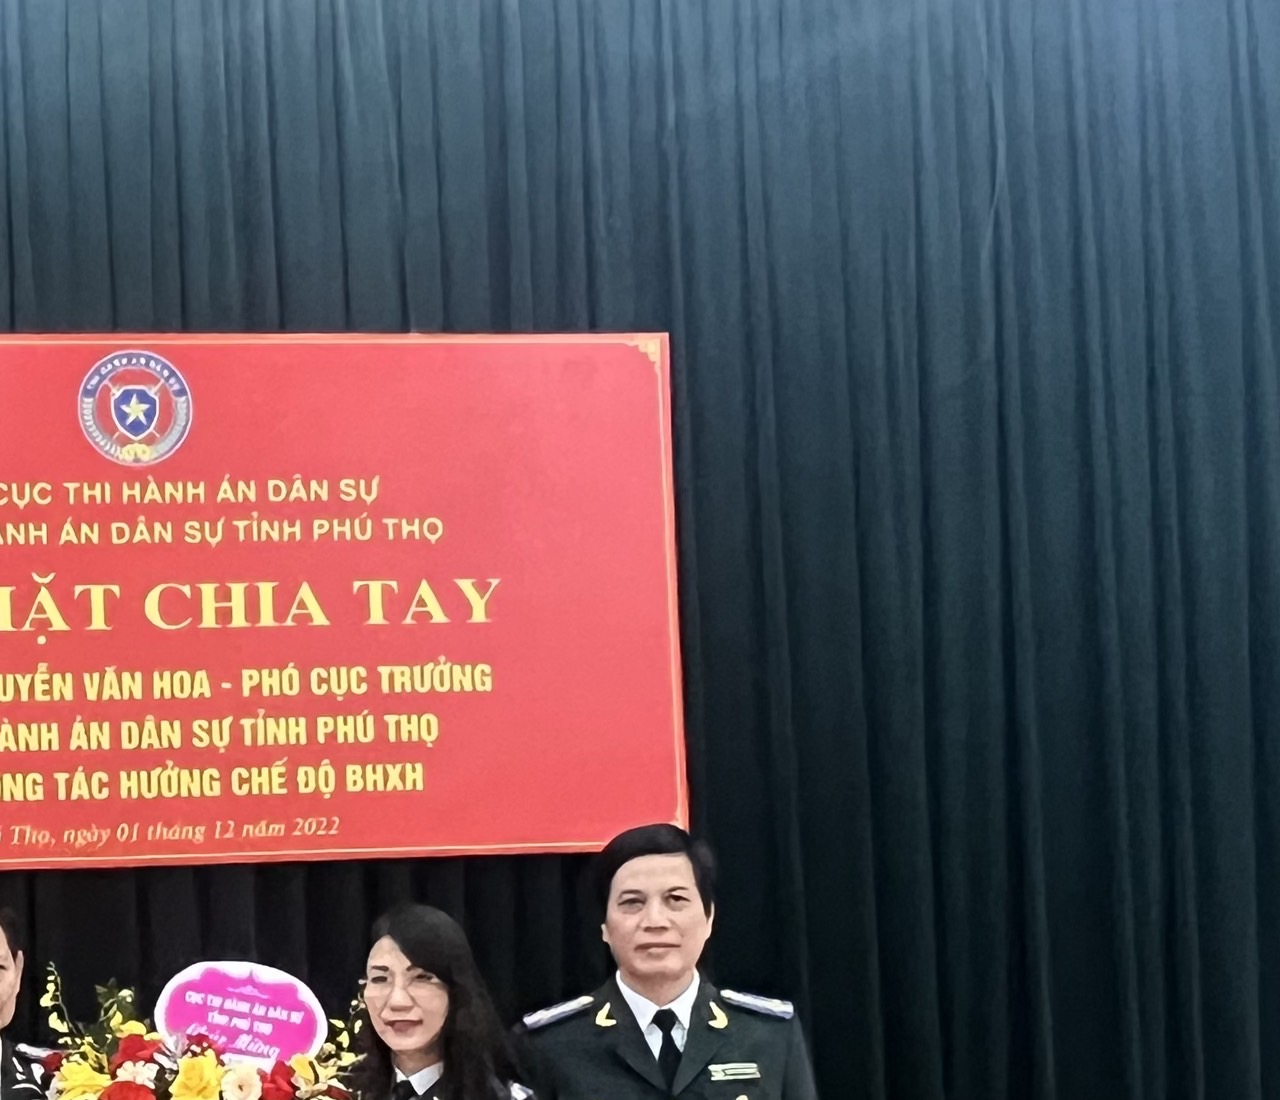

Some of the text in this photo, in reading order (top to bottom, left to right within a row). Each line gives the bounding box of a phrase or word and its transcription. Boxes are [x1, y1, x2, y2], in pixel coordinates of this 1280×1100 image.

[62, 481, 111, 506] THI
[122, 475, 206, 505] HÀNH
[216, 473, 257, 504] ÁN
[267, 473, 329, 503] DÂN
[339, 474, 380, 506] SỰ
[58, 516, 100, 546] ÁN
[110, 514, 173, 545] DÂN
[183, 516, 226, 548] SỰ
[231, 510, 302, 543] TỈNH
[312, 511, 373, 542] PHÚ
[381, 516, 444, 545] THỌ
[144, 580, 331, 631] CHIA
[352, 577, 501, 625] TAY
[82, 665, 143, 702] VĂN
[152, 669, 212, 700] HOA
[241, 661, 301, 698] PHÓ
[309, 665, 368, 702] CỤC
[376, 654, 493, 694] TRƯỞNG
[69, 715, 111, 751] ÁN
[120, 714, 182, 750] DÂN
[191, 715, 234, 754] SỰ
[239, 709, 308, 747] TỈNH
[316, 709, 375, 744] PHÚ
[383, 712, 439, 748] THỌ
[52, 765, 110, 801] TÁC
[119, 759, 222, 800] HƯỞNG
[230, 757, 288, 797] CHẾ
[296, 758, 336, 800] ĐỘ
[345, 762, 425, 793] BHXH
